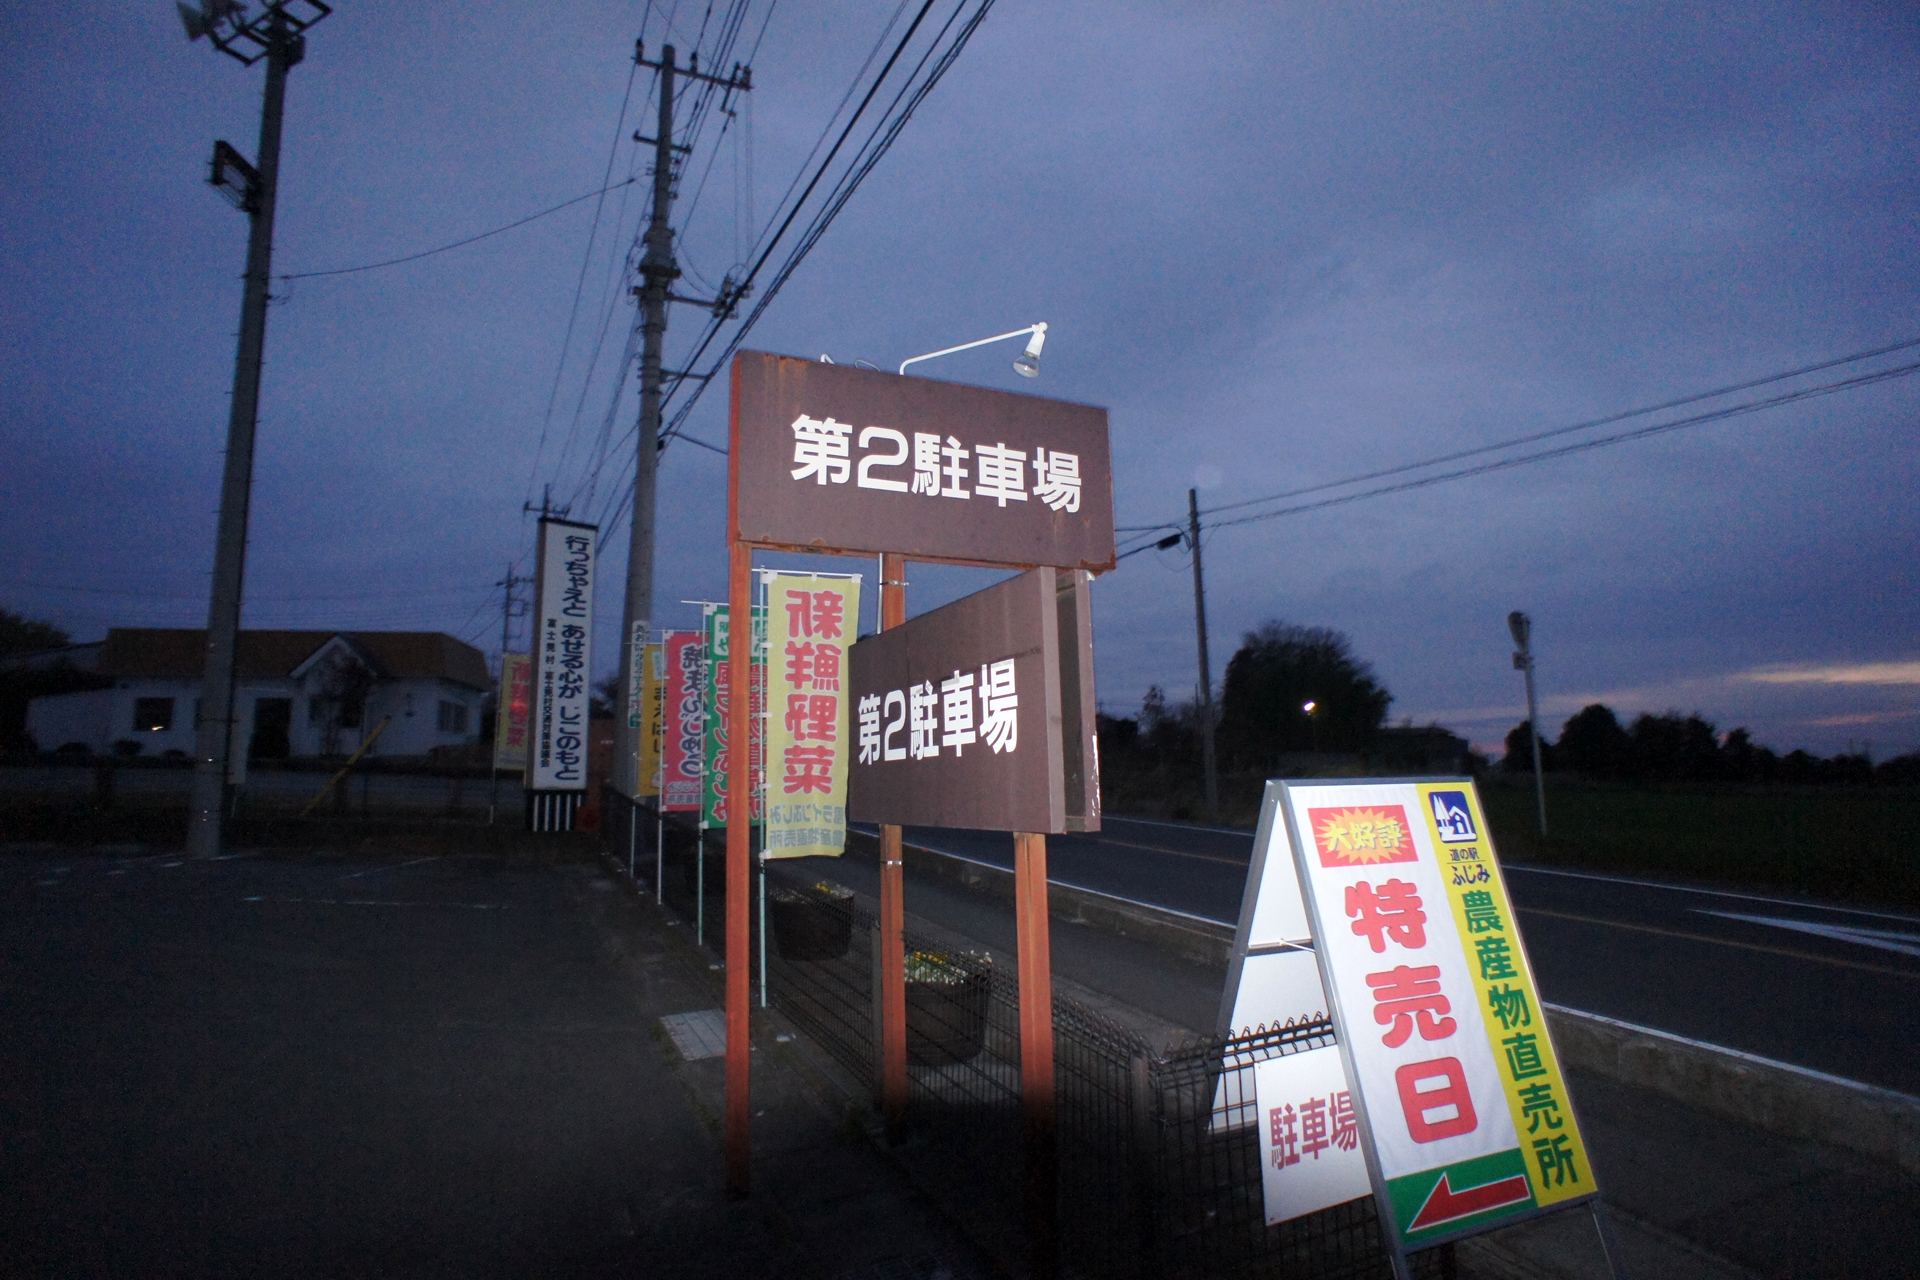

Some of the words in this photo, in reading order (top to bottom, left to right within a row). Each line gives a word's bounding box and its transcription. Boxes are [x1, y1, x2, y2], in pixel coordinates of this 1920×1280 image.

[790, 414, 1082, 513] 第2駐車場
[558, 624, 587, 699] あせる心が
[554, 705, 582, 781] じこのもと
[858, 658, 1018, 765] 第2駐車場
[1320, 819, 1402, 852] 大好評
[1449, 847, 1480, 861] 道の駅
[1451, 863, 1491, 886] ふじみ
[1344, 878, 1479, 1144] 特売日
[1461, 889, 1579, 1191] 農産物直売所
[1269, 1090, 1357, 1170] 駐車場
